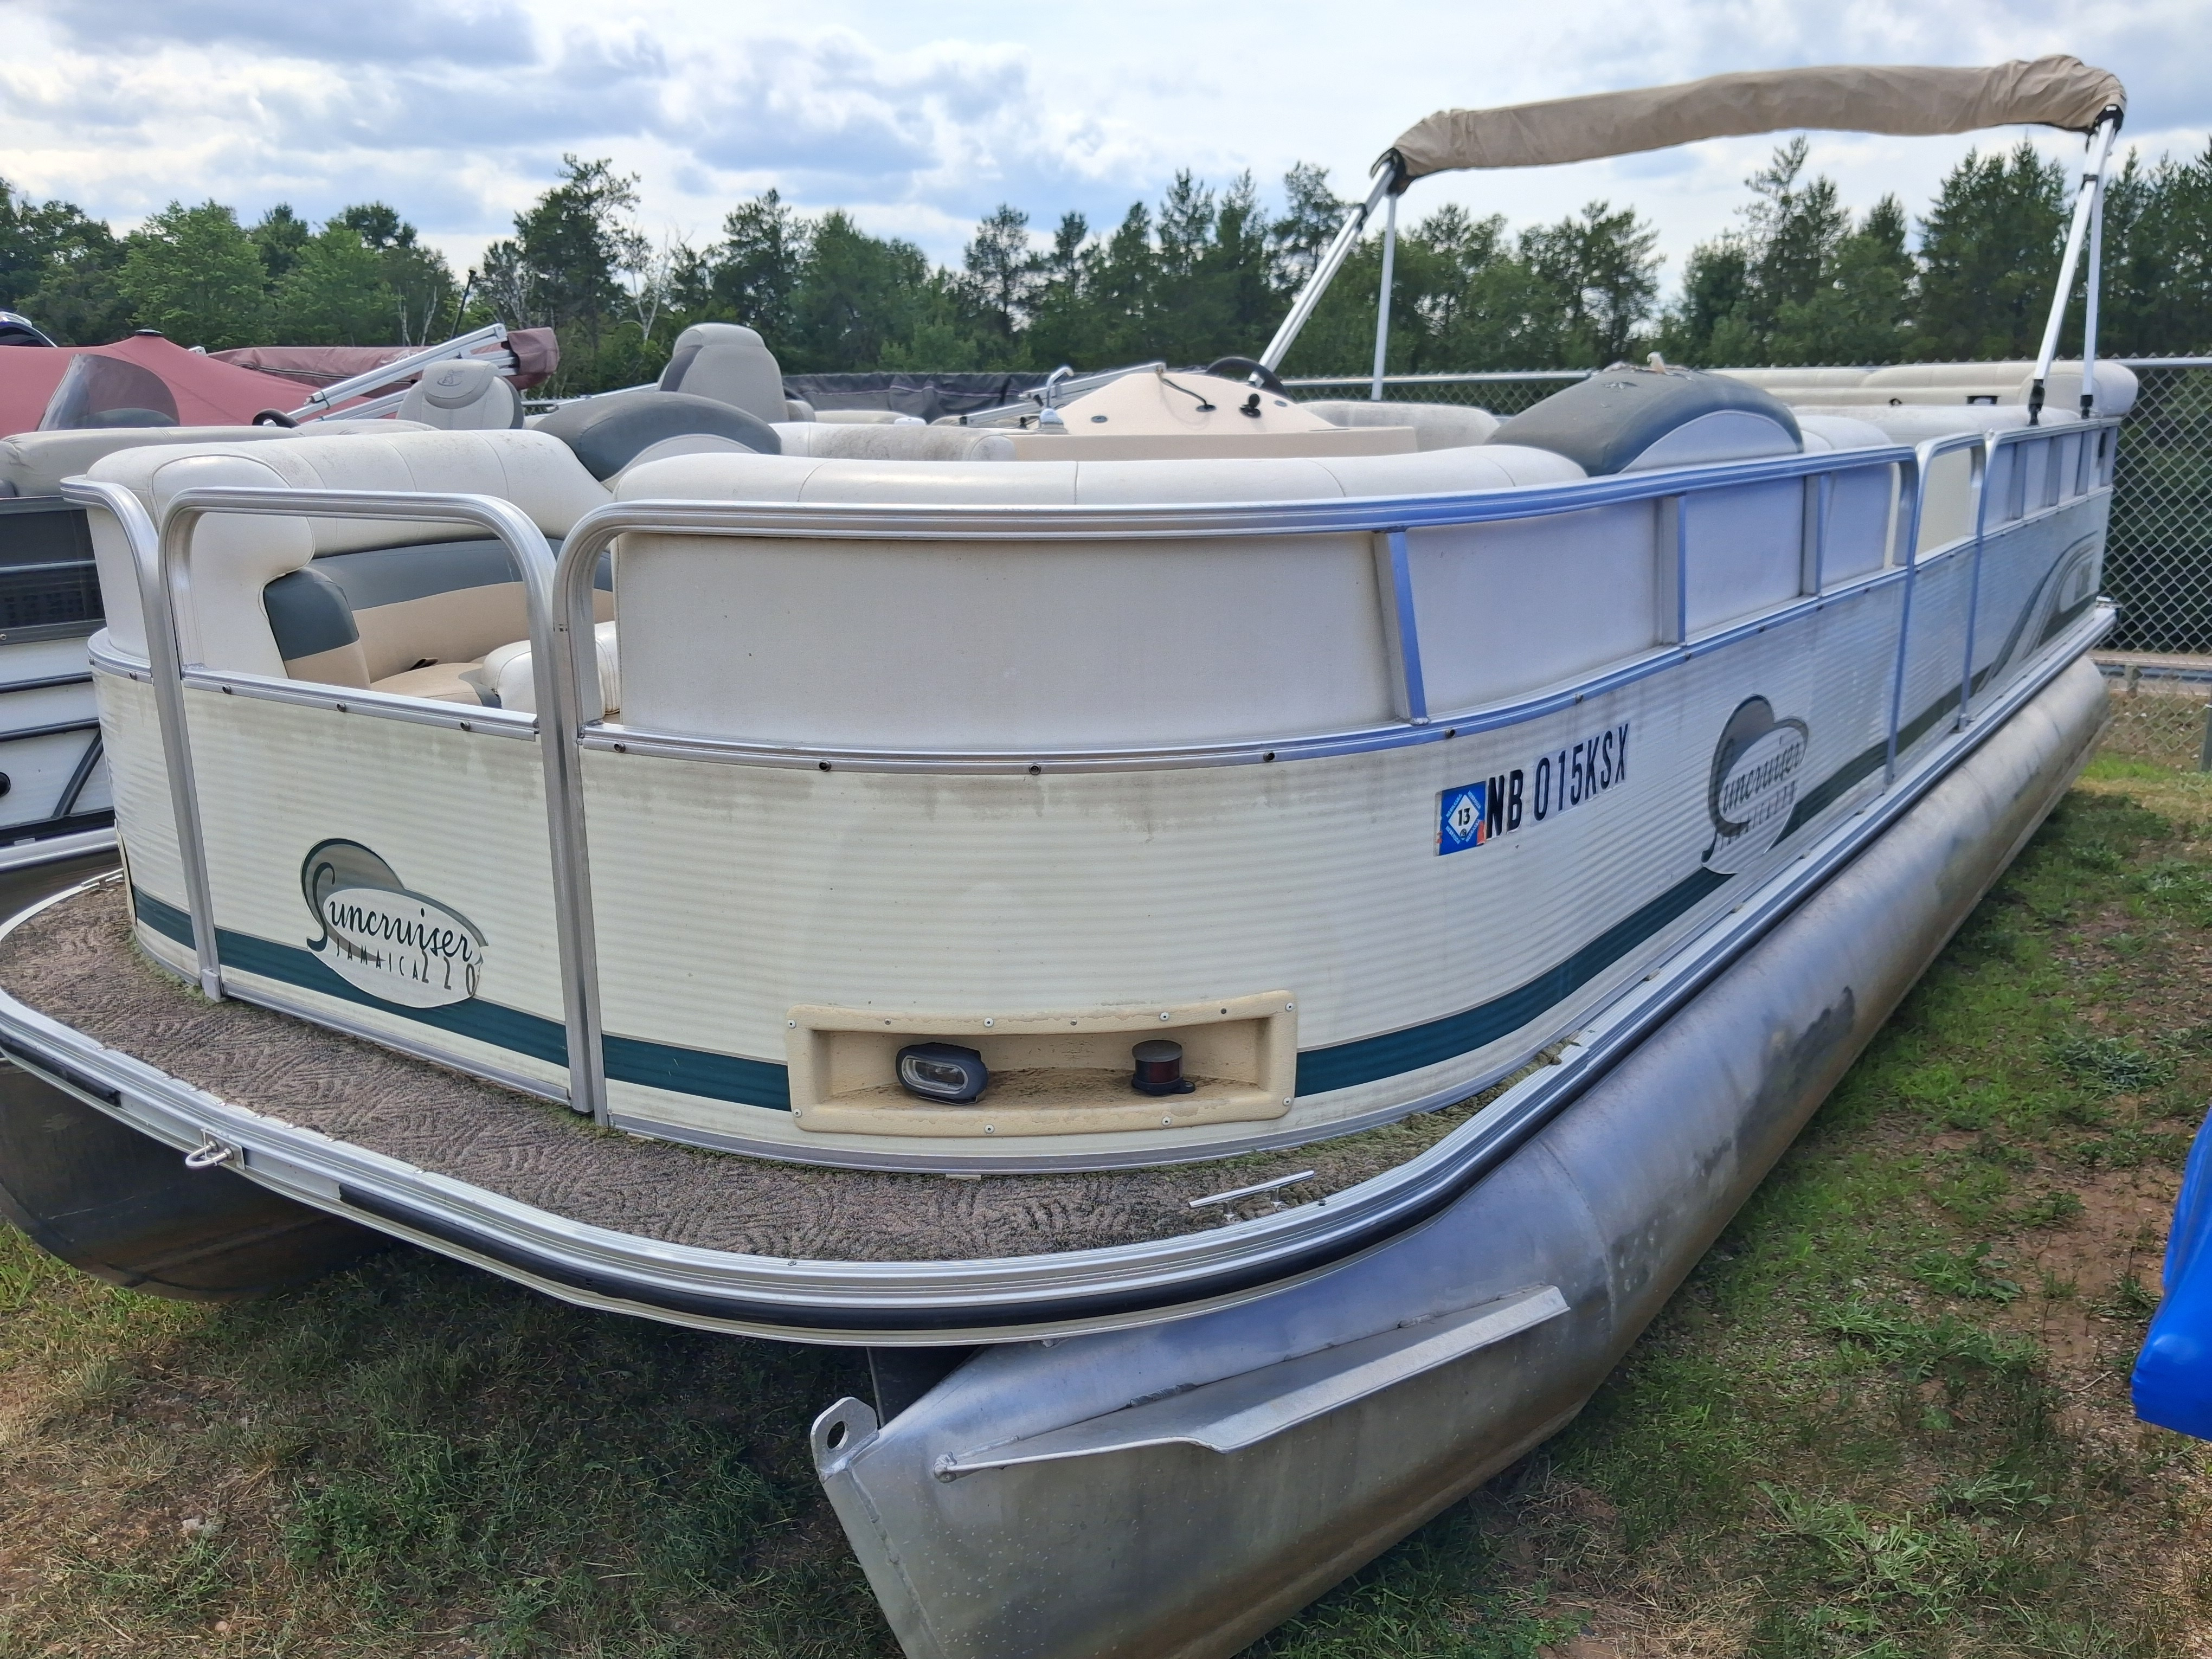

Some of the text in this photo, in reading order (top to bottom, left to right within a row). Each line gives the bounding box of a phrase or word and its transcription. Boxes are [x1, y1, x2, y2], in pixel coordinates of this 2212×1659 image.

[1458, 807, 1471, 826] 13
[1486, 723, 1629, 839] NB 015KSX
[306, 861, 473, 962] Suncruiser
[335, 937, 419, 980] JAMAICA
